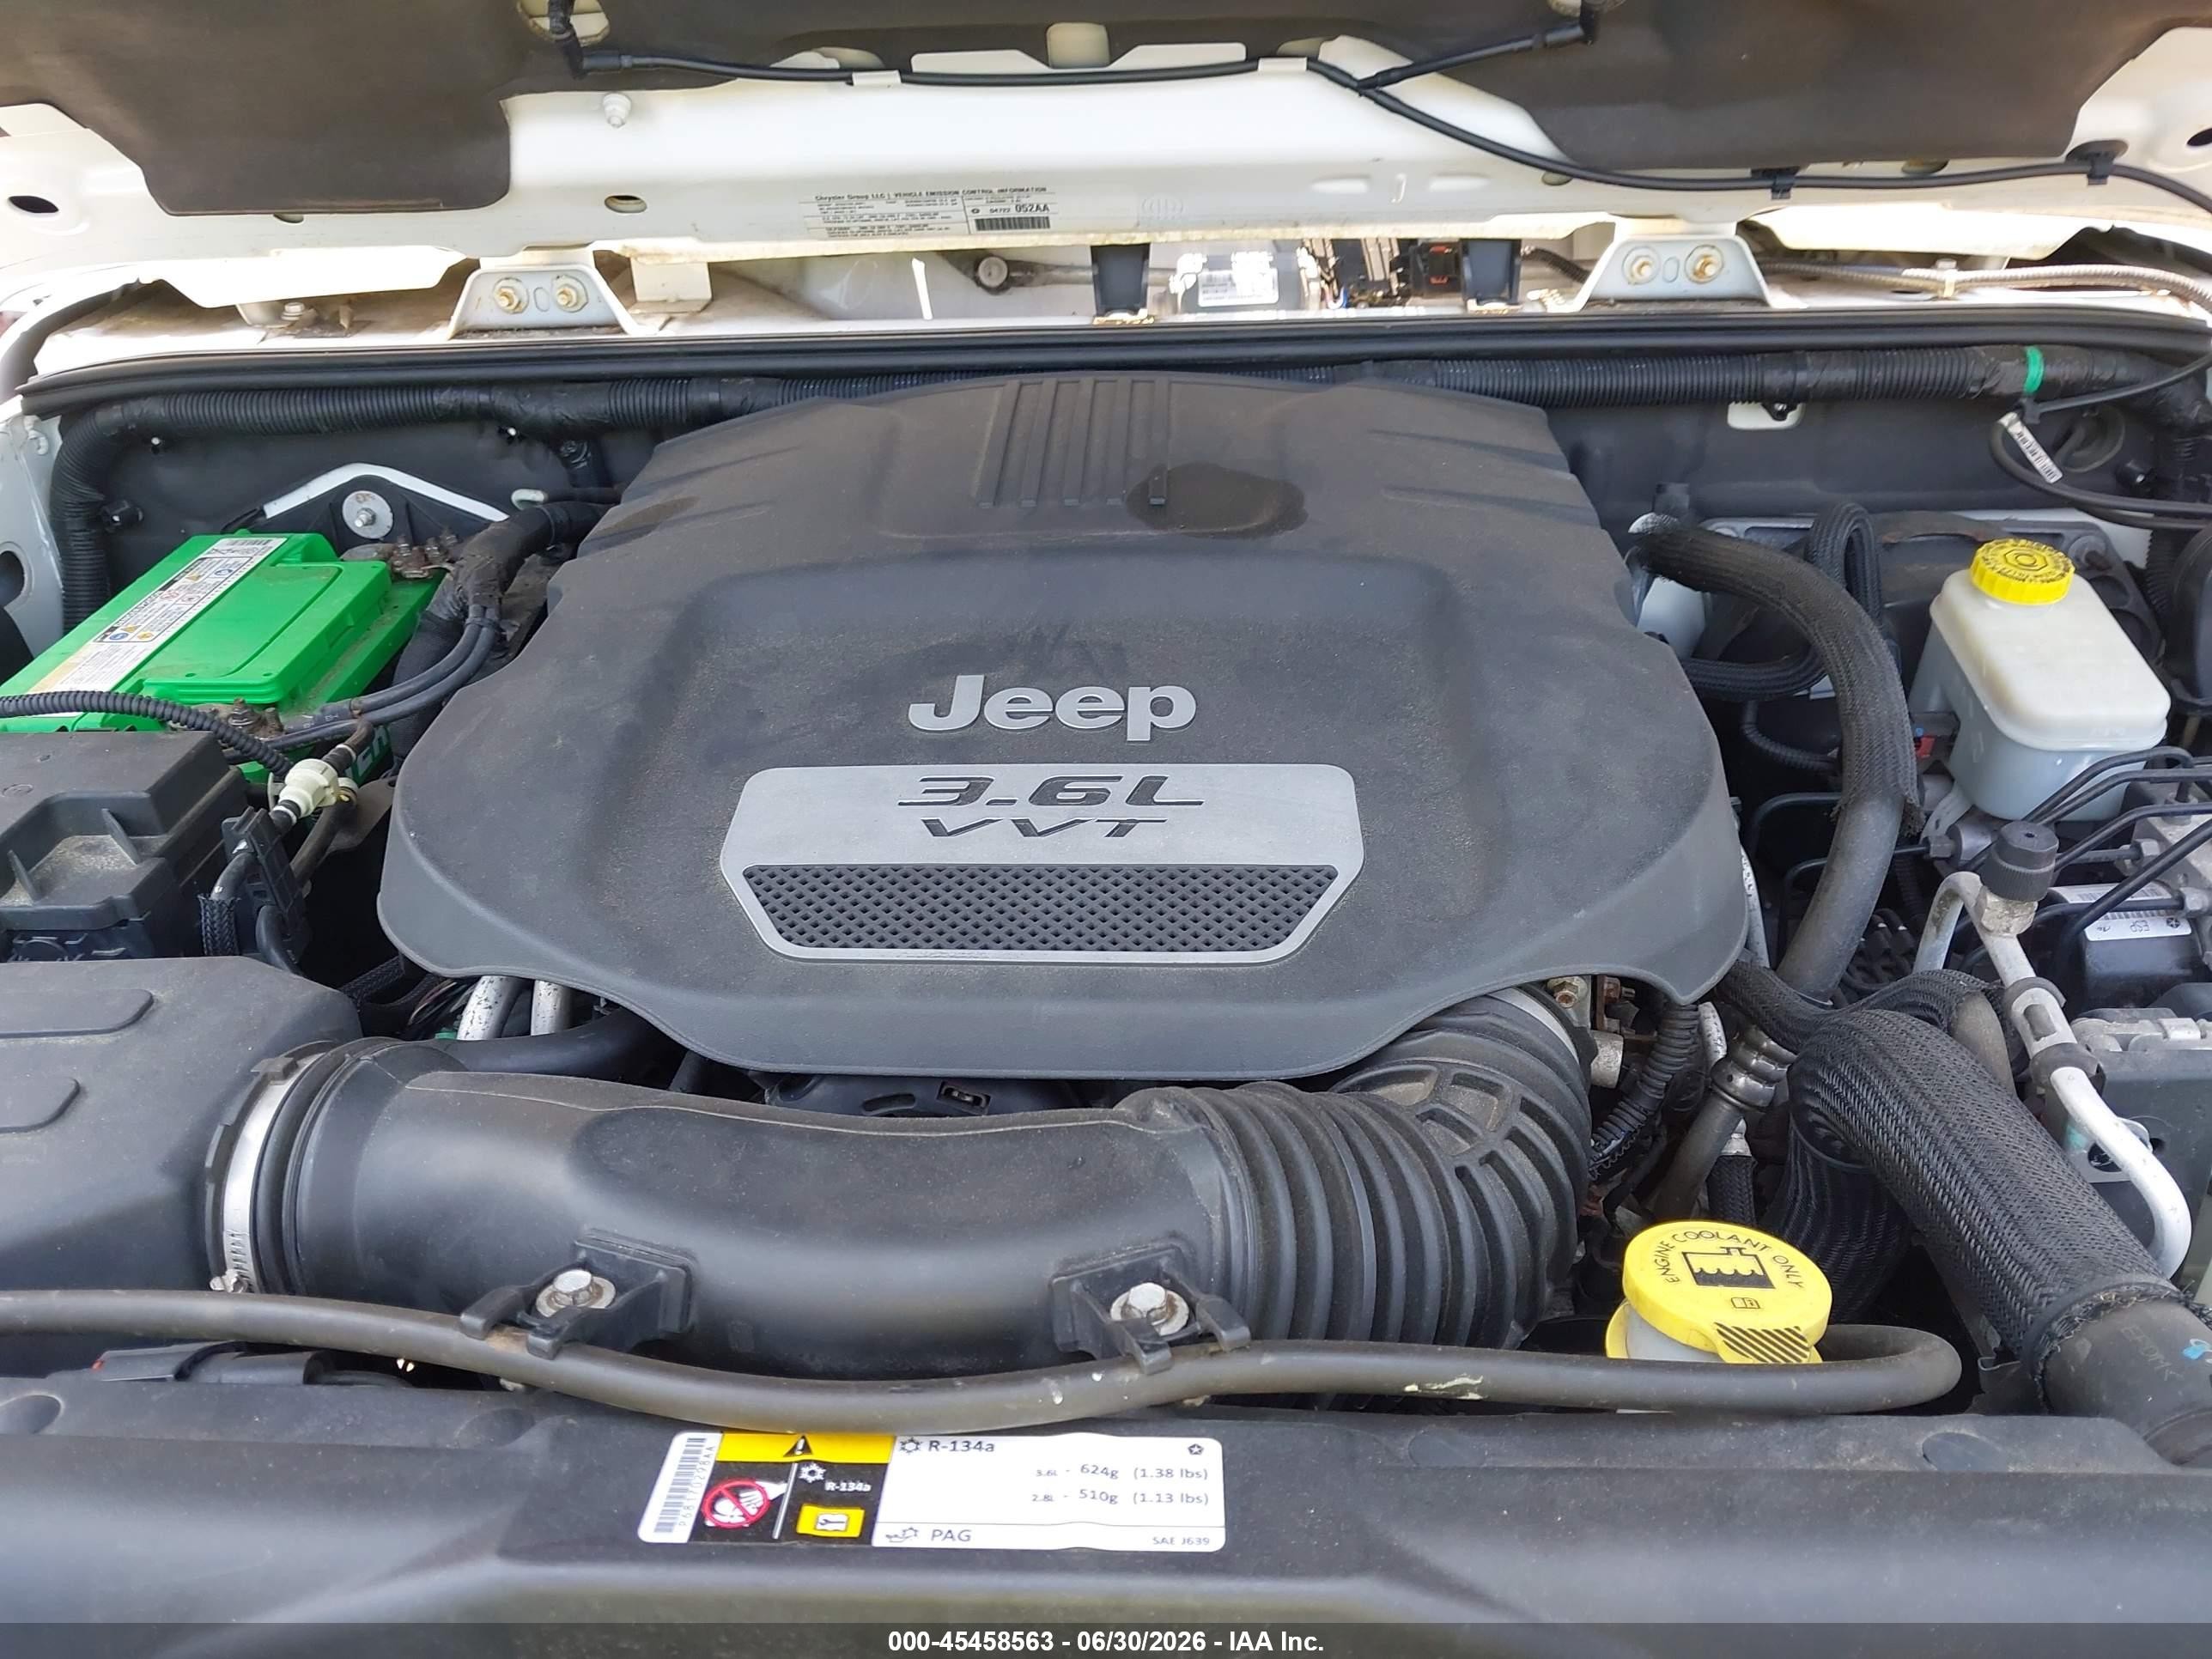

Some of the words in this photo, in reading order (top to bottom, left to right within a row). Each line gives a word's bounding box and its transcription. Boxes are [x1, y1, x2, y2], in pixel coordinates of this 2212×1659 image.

[1014, 203, 1050, 213] 052AA
[908, 675, 1198, 742] Jeep
[898, 775, 1205, 806] 3.6L
[921, 818, 1169, 838] VVT
[1654, 1240, 1681, 1284] ENGINE
[1671, 1230, 1771, 1253] COOLANT
[1772, 1255, 1805, 1289] ONLY
[927, 1439, 995, 1453] R-134a
[1079, 1463, 1120, 1480] 624g
[1133, 1467, 1175, 1480] (1.38
[1179, 1468, 1209, 1480] lbs)
[823, 1480, 872, 1492] R-134a
[1079, 1488, 1119, 1504] 510g
[1133, 1492, 1175, 1504] (1.13
[1179, 1492, 1209, 1505] lbs)
[930, 1528, 972, 1542] PAG
[1152, 1536, 1176, 1546] SAE
[1181, 1536, 1210, 1546] J639
